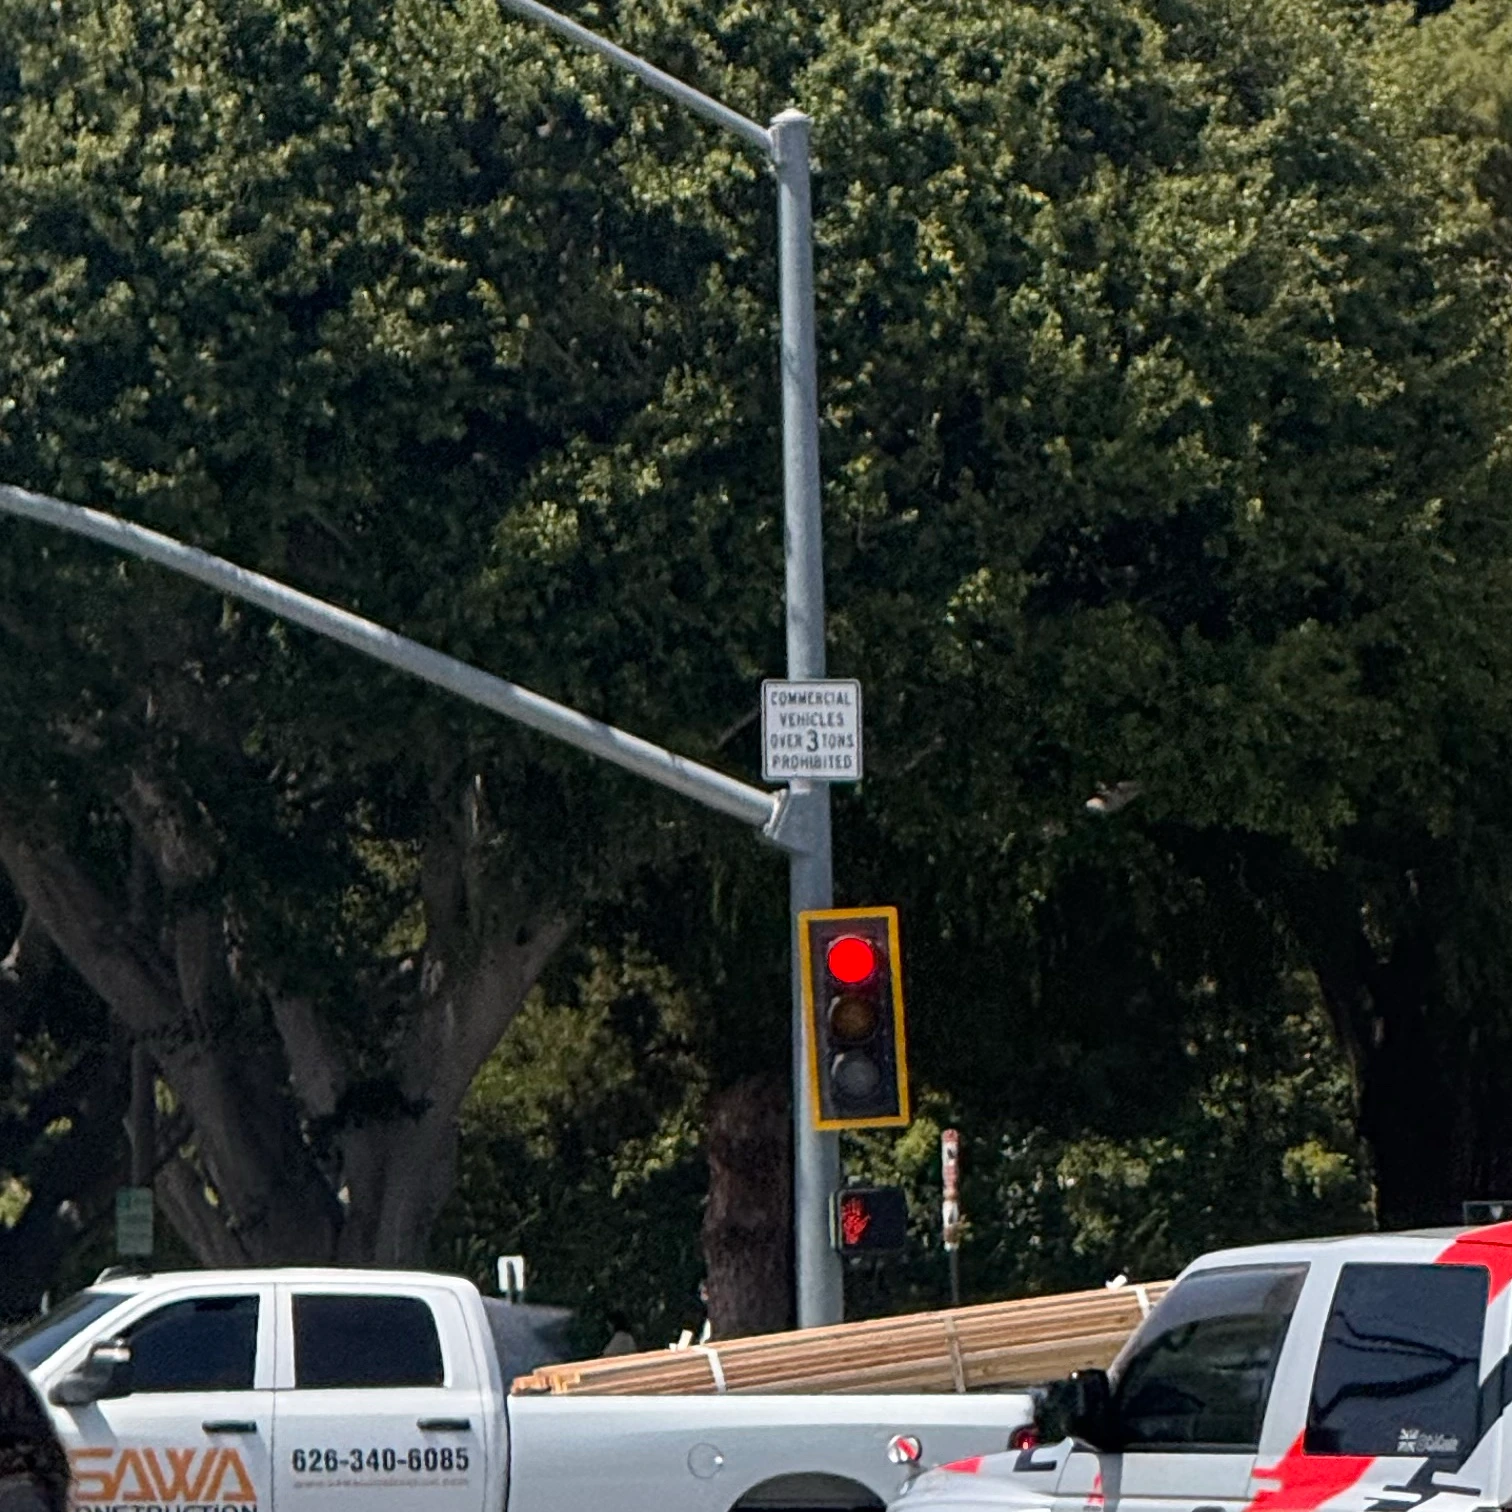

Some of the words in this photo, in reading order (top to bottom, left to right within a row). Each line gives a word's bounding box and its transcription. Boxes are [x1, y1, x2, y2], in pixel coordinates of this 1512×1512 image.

[770, 691, 851, 706] COMMERCIAL
[780, 711, 844, 727] VEHICLES
[770, 733, 802, 749] OVER
[806, 729, 819, 752] 3
[822, 733, 854, 748] TONS
[772, 754, 853, 769] PROHIBITED
[69, 1446, 257, 1501] SAWA
[292, 1447, 470, 1473] 626-340-6085
